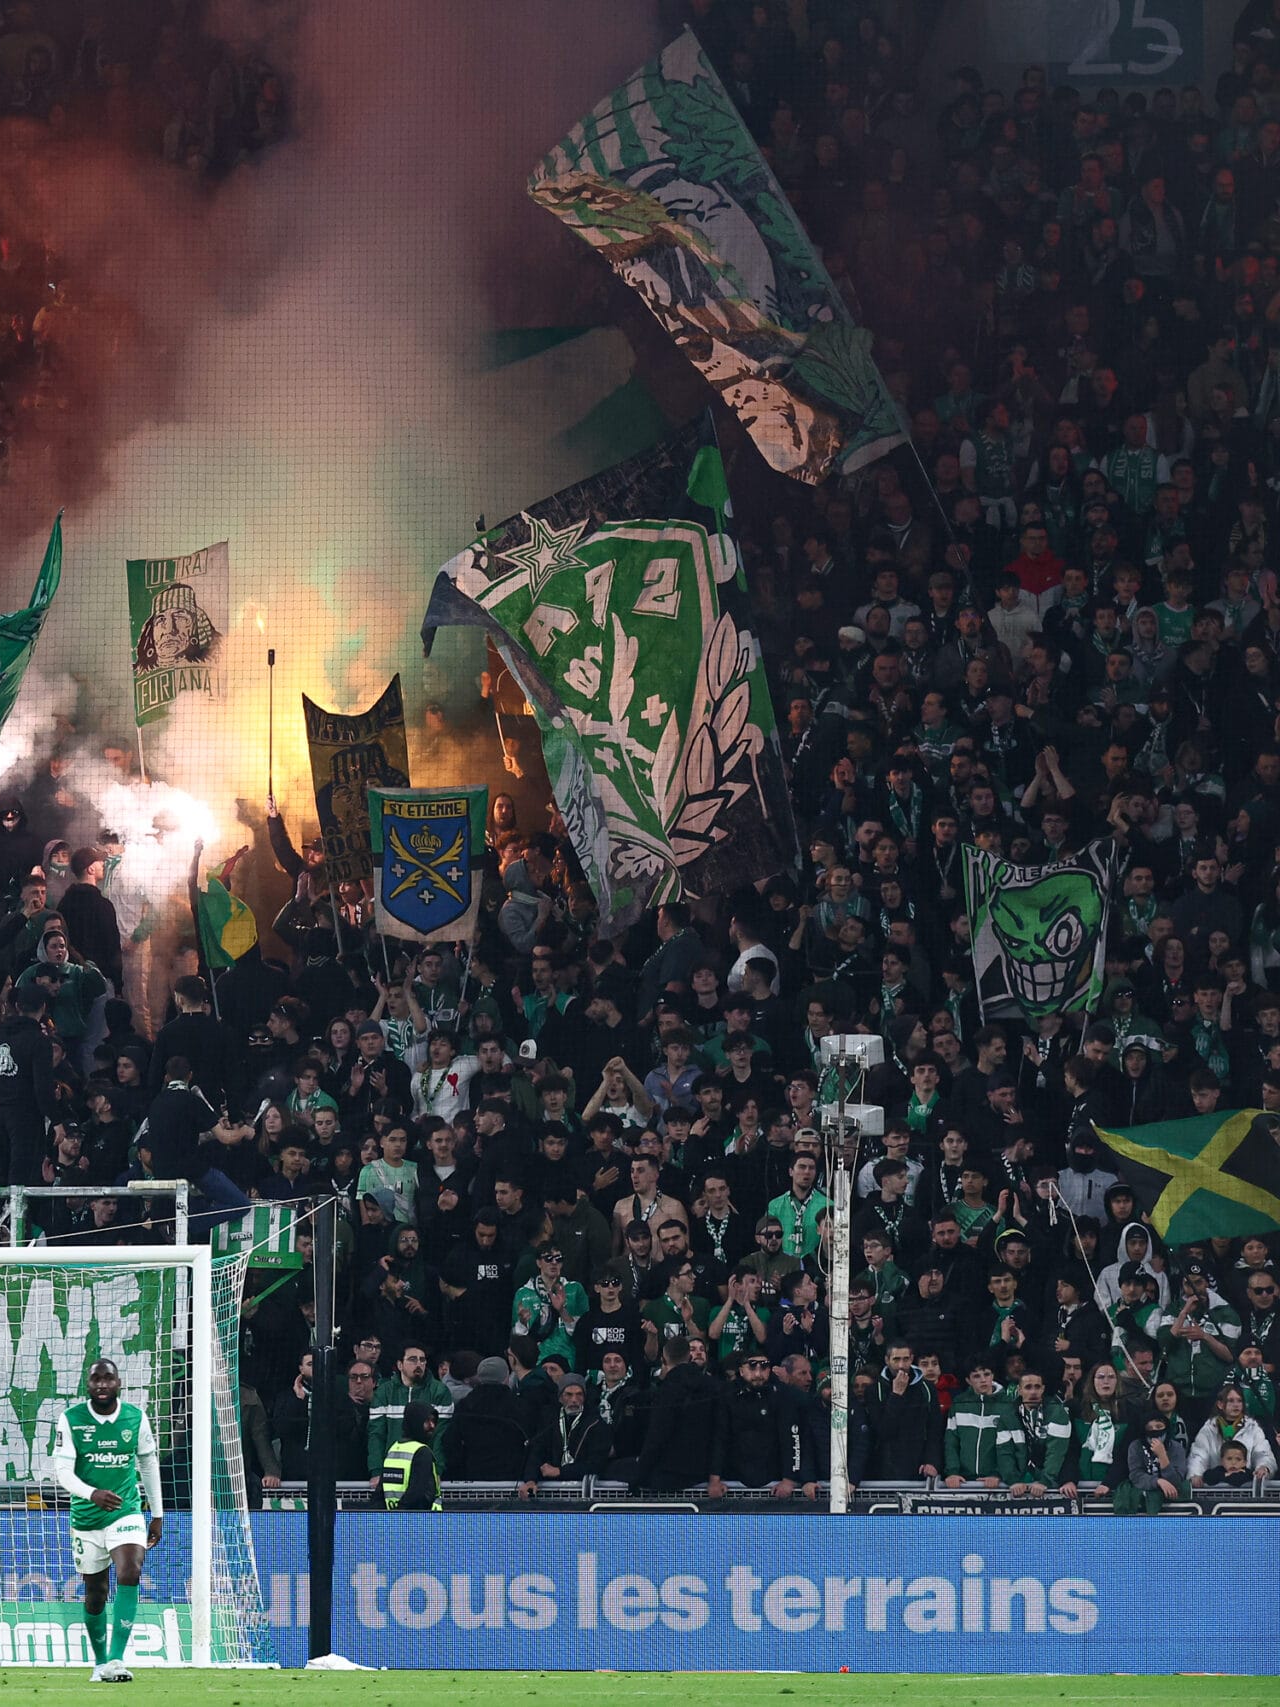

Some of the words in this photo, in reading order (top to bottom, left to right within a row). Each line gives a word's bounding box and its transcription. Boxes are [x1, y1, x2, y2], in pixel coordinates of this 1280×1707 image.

[149, 555, 204, 585] ULTRA
[389, 802, 404, 816] ST
[407, 800, 463, 817] ETIENNE
[94, 1452, 130, 1465] Kelyps
[351, 1562, 559, 1631] tous
[577, 1552, 710, 1633] les
[725, 1554, 1100, 1635] terrains
